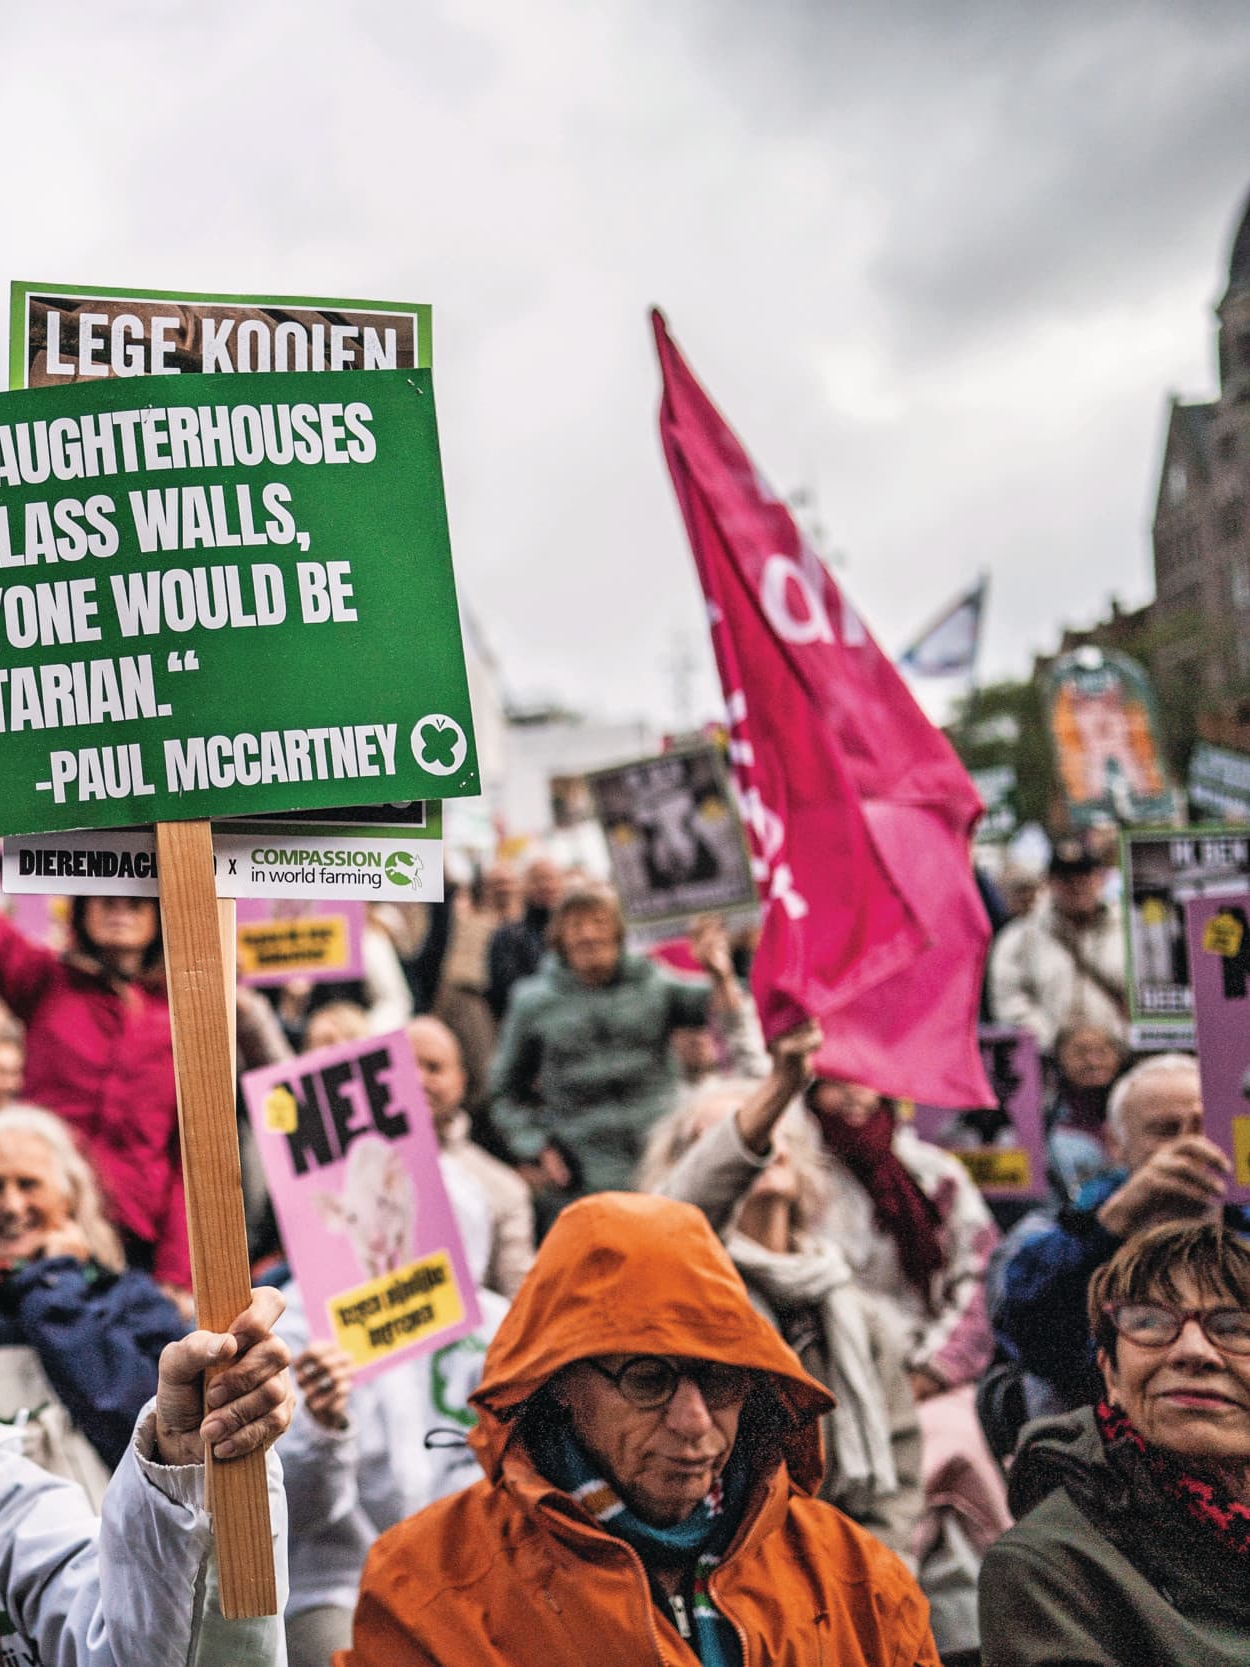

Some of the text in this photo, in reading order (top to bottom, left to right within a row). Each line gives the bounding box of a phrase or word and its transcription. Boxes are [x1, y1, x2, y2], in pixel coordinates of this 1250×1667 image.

[47, 311, 181, 376] LEGE
[129, 483, 311, 552] WALLS,
[111, 564, 286, 637] WOULD
[296, 561, 358, 623] BE
[165, 723, 398, 792] MCCARTNEY
[19, 850, 217, 879] DIERENDAG
[251, 849, 382, 867] COMPASSION
[251, 866, 382, 889] in world farming
[273, 1048, 410, 1178] NEE
